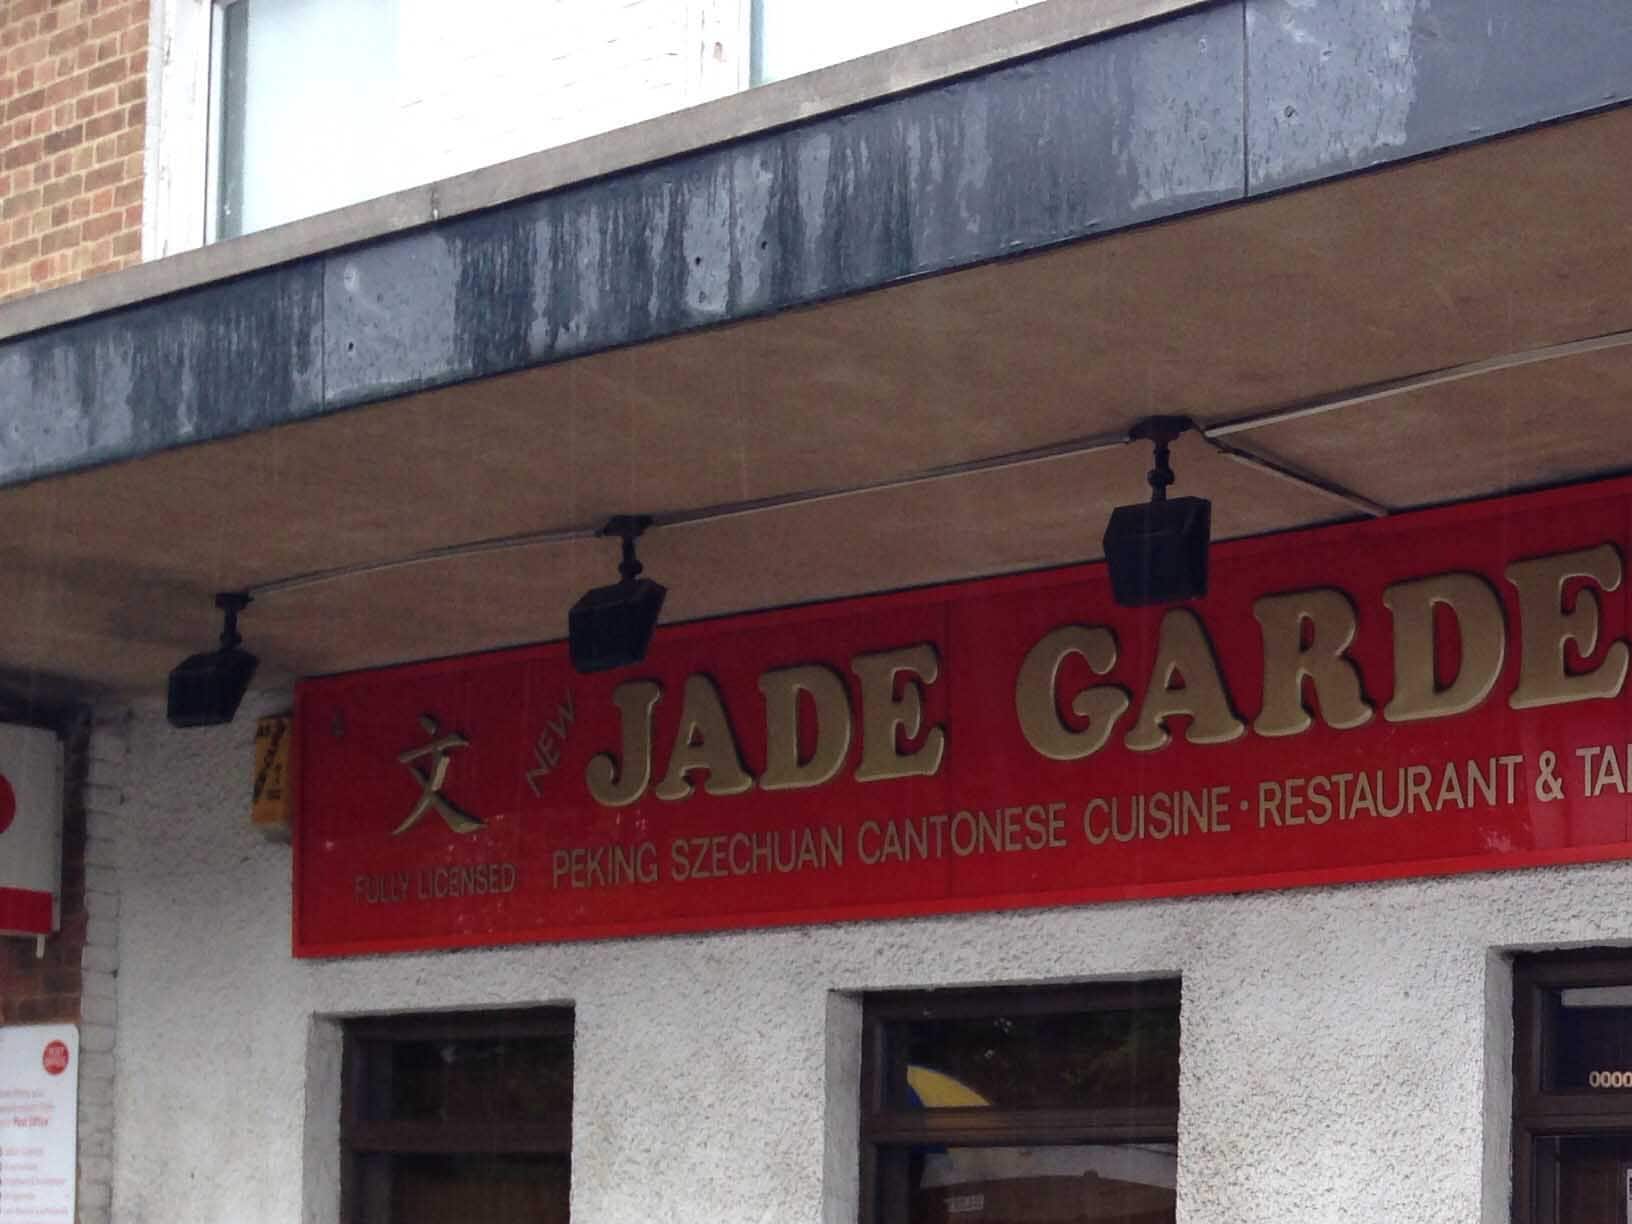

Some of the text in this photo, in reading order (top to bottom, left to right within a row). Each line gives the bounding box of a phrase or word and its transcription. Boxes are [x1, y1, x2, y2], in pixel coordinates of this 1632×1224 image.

[391, 713, 487, 836] 文
[524, 687, 577, 800] NEW
[586, 643, 945, 807] JADE
[553, 845, 659, 889] PEKING
[671, 826, 845, 882] SZECHUAN
[857, 803, 1067, 867] CANTONESE
[1084, 786, 1231, 843] CUISINE
[1258, 755, 1524, 828] RESTAURANT
[1536, 750, 1565, 802] &
[353, 863, 517, 904] FULLY LICENSED
